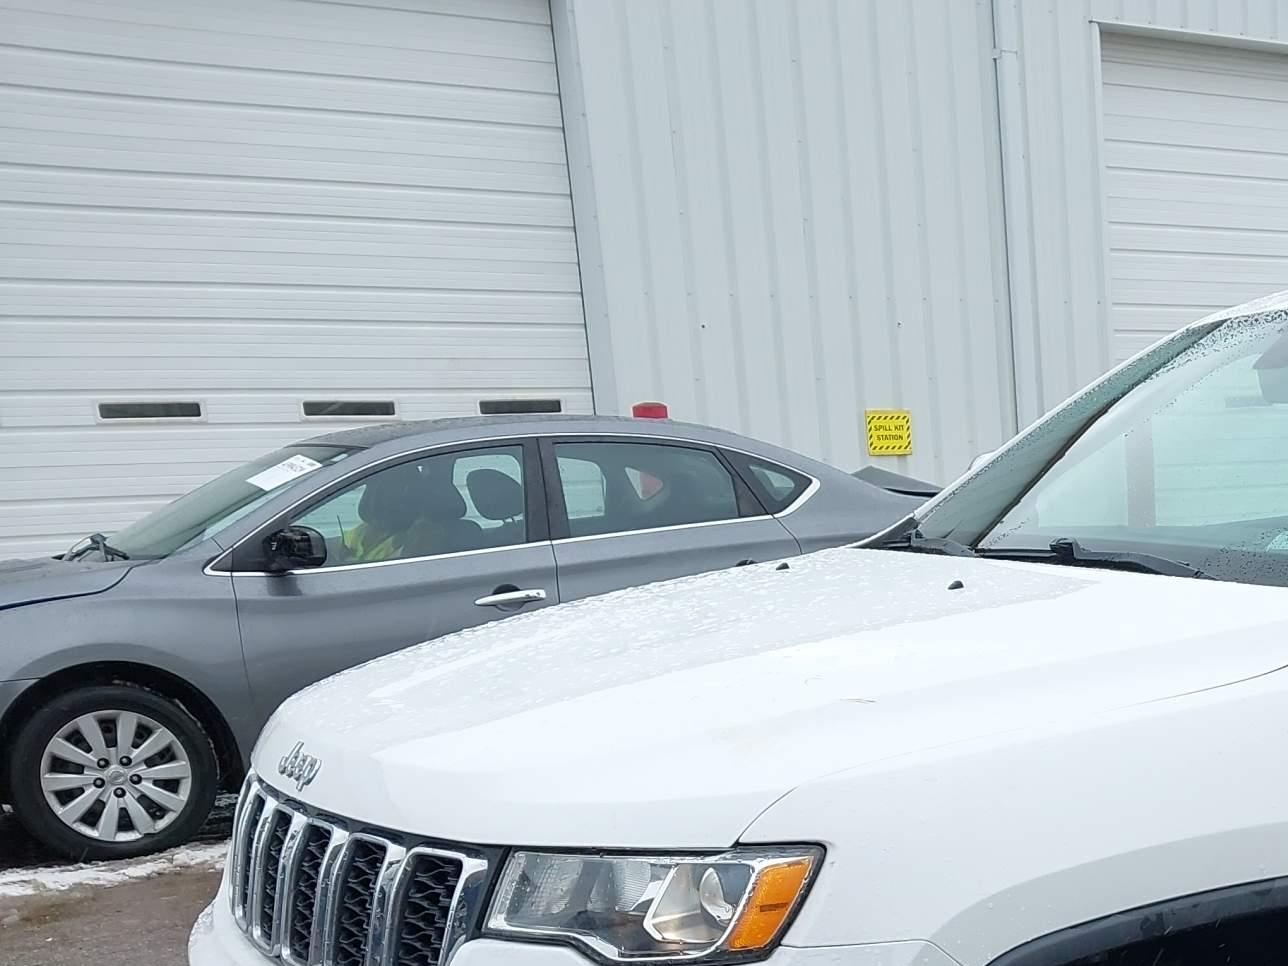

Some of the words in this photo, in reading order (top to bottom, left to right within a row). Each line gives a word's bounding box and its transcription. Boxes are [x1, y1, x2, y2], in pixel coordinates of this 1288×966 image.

[873, 424, 893, 432] SPILL
[894, 424, 905, 432] KIT
[279, 740, 322, 792] Jeep
